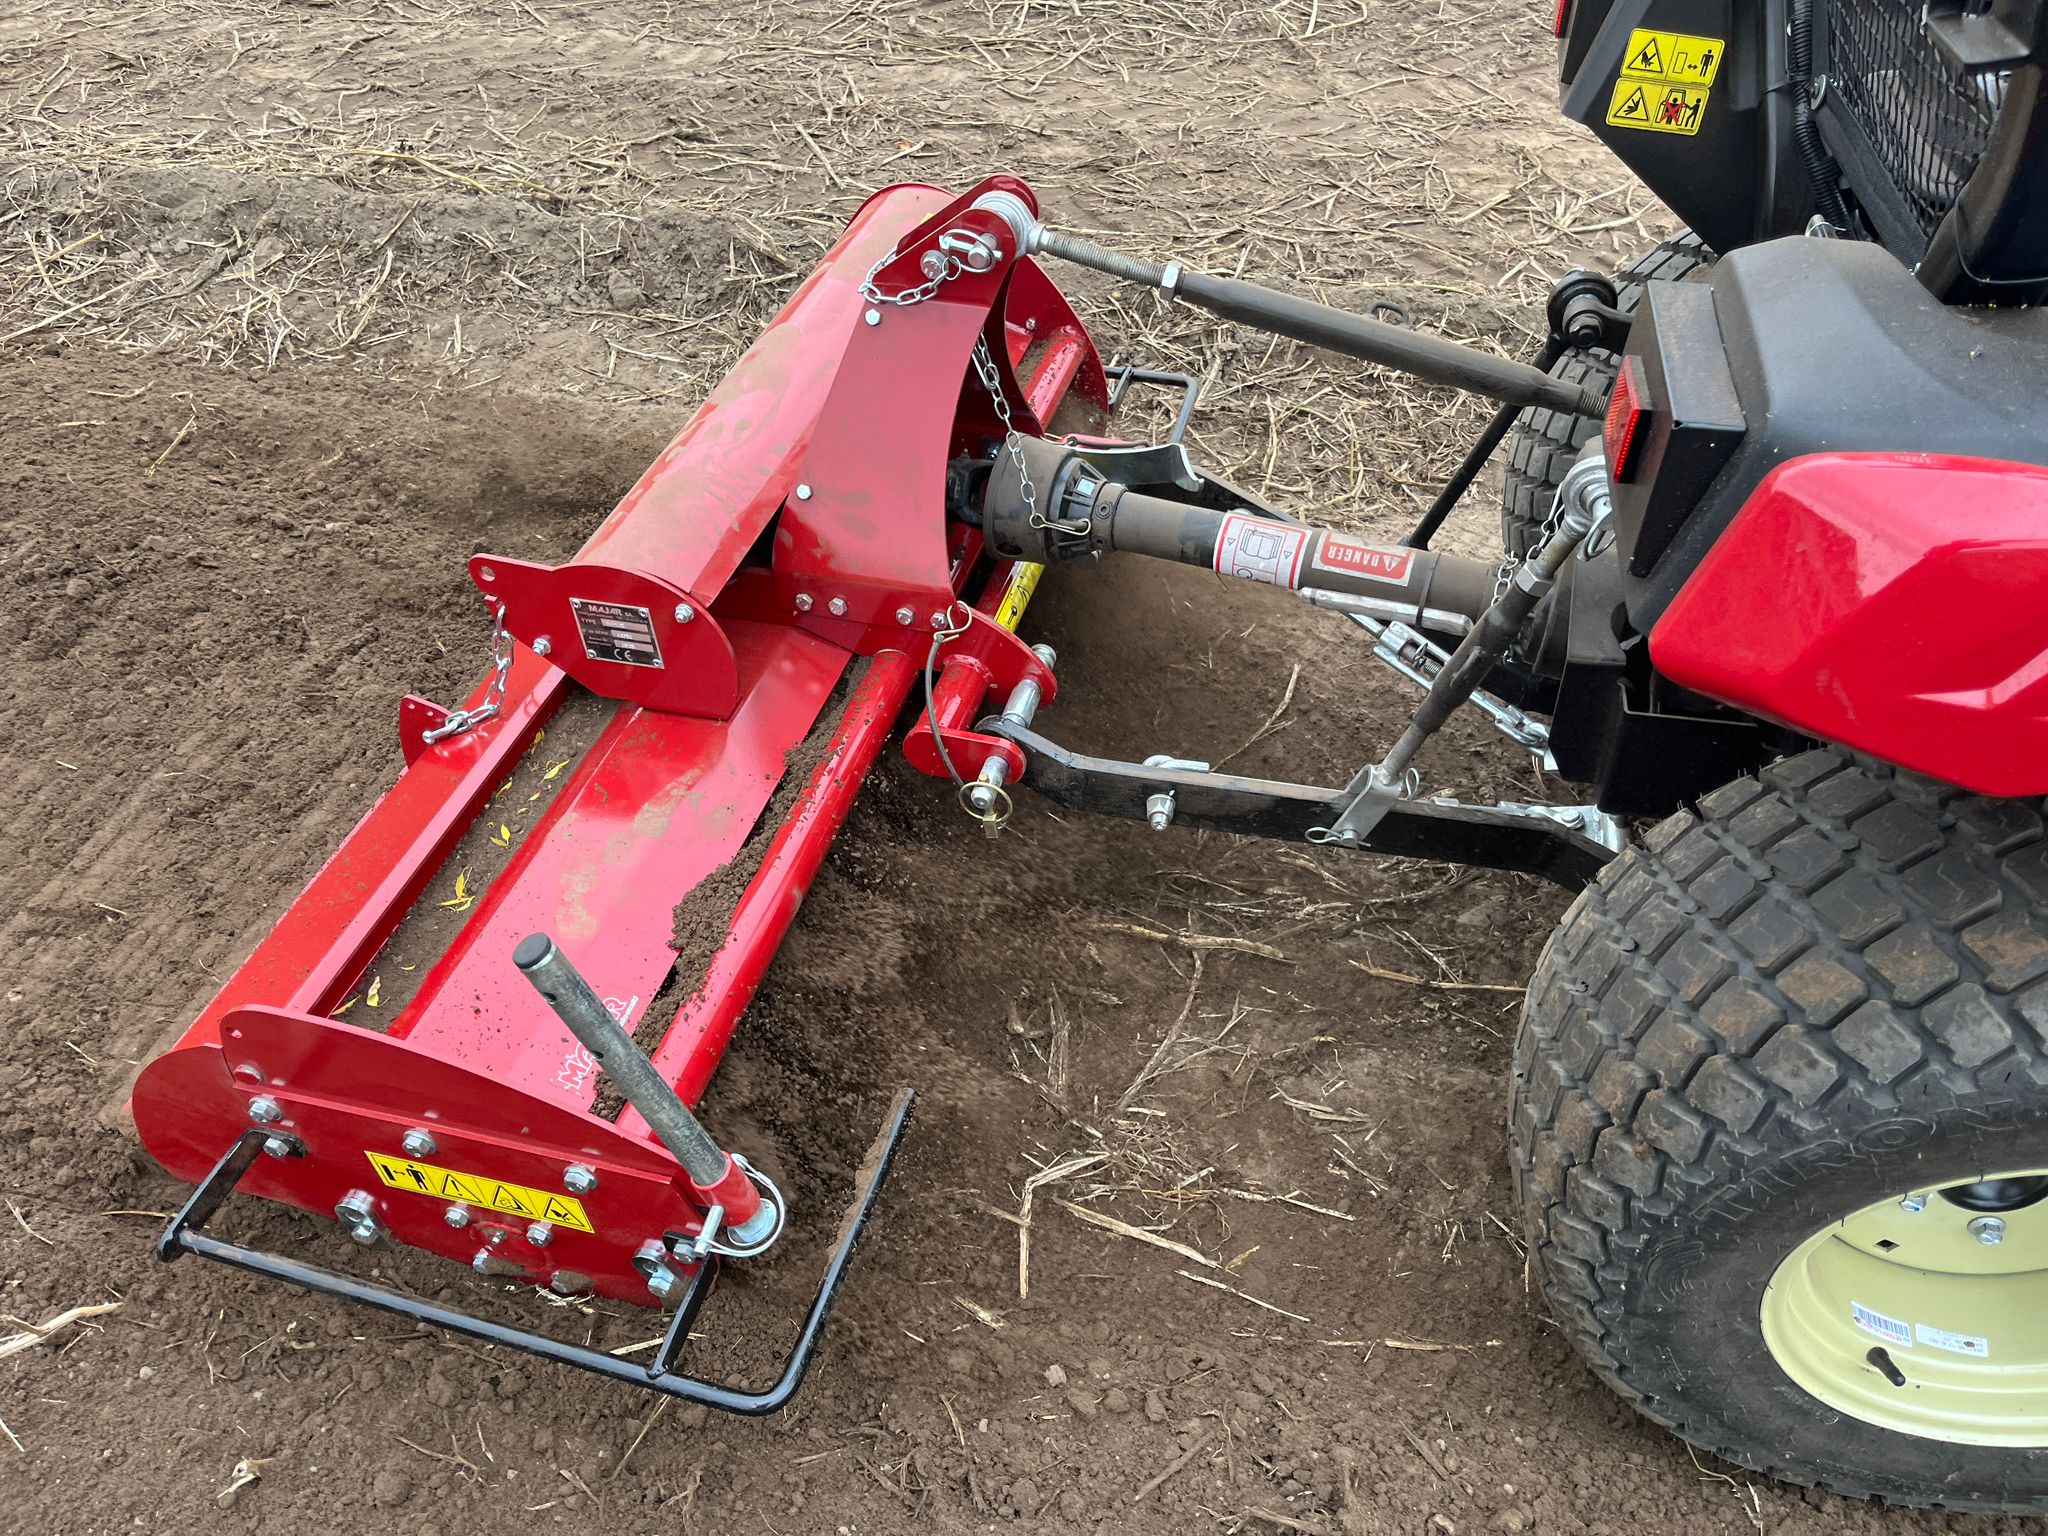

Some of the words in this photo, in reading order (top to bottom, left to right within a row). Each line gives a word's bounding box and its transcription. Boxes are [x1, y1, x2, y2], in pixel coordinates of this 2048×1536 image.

[1327, 544, 1381, 568] DANGER
[588, 604, 622, 616] MAJAR
[613, 648, 633, 661] CE
